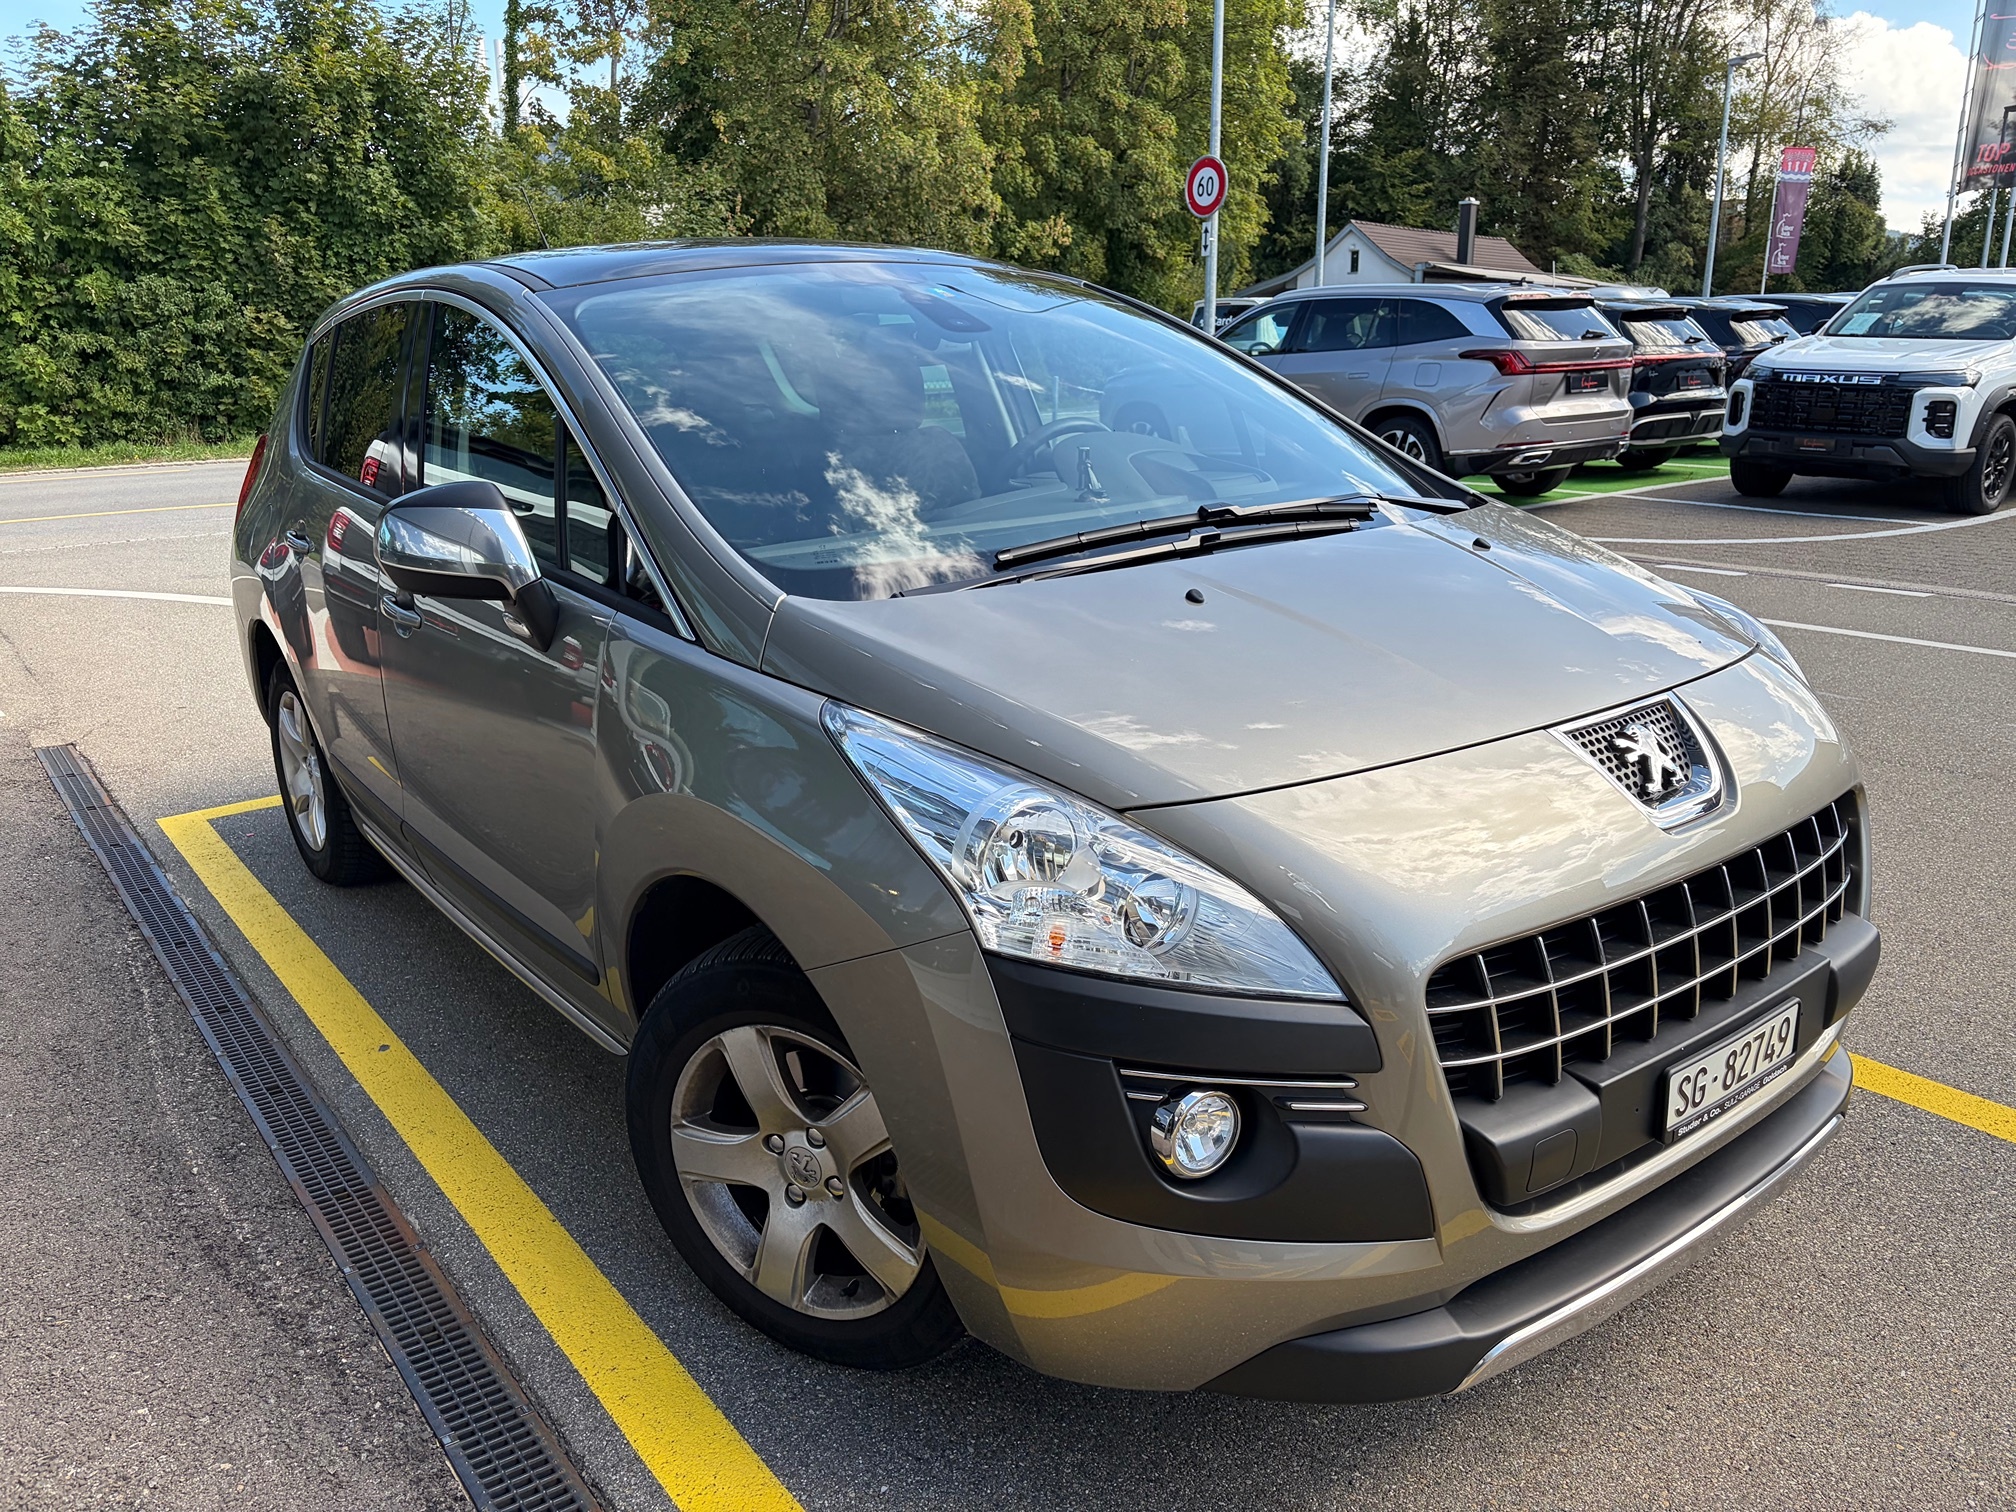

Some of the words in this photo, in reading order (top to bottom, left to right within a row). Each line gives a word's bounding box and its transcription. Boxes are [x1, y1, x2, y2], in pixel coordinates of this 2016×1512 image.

[1977, 142, 2010, 162] TOP
[1197, 176, 1214, 197] 60
[1782, 373, 1882, 385] MAXUS
[1678, 1118, 1702, 1136] Studer
[1703, 1113, 1709, 1122] &
[1710, 1108, 1721, 1118] Co.
[1762, 1065, 1787, 1084] Goldach
